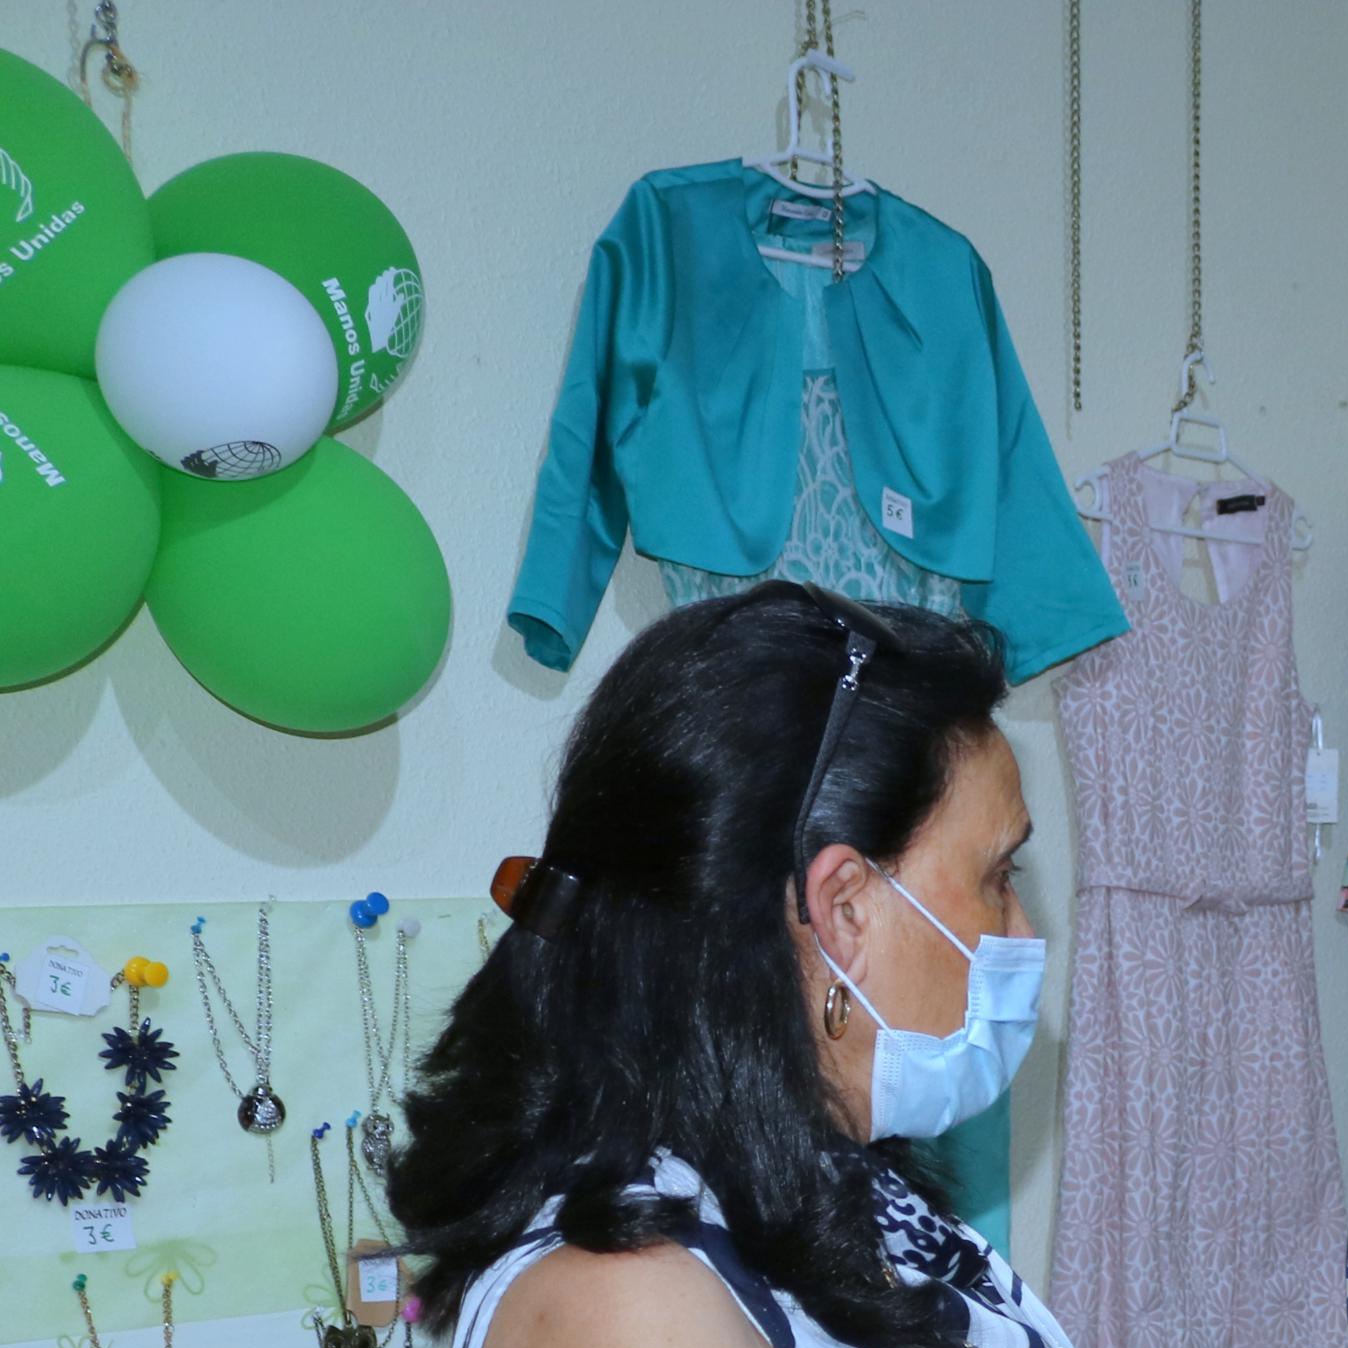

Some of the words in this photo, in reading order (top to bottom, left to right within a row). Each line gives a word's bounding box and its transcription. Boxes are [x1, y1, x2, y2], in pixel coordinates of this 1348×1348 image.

[9, 201, 85, 261] Unidas
[321, 277, 360, 356] Manos
[75, 1207, 127, 1220] DONATIVO
[83, 1223, 115, 1245] 3€
